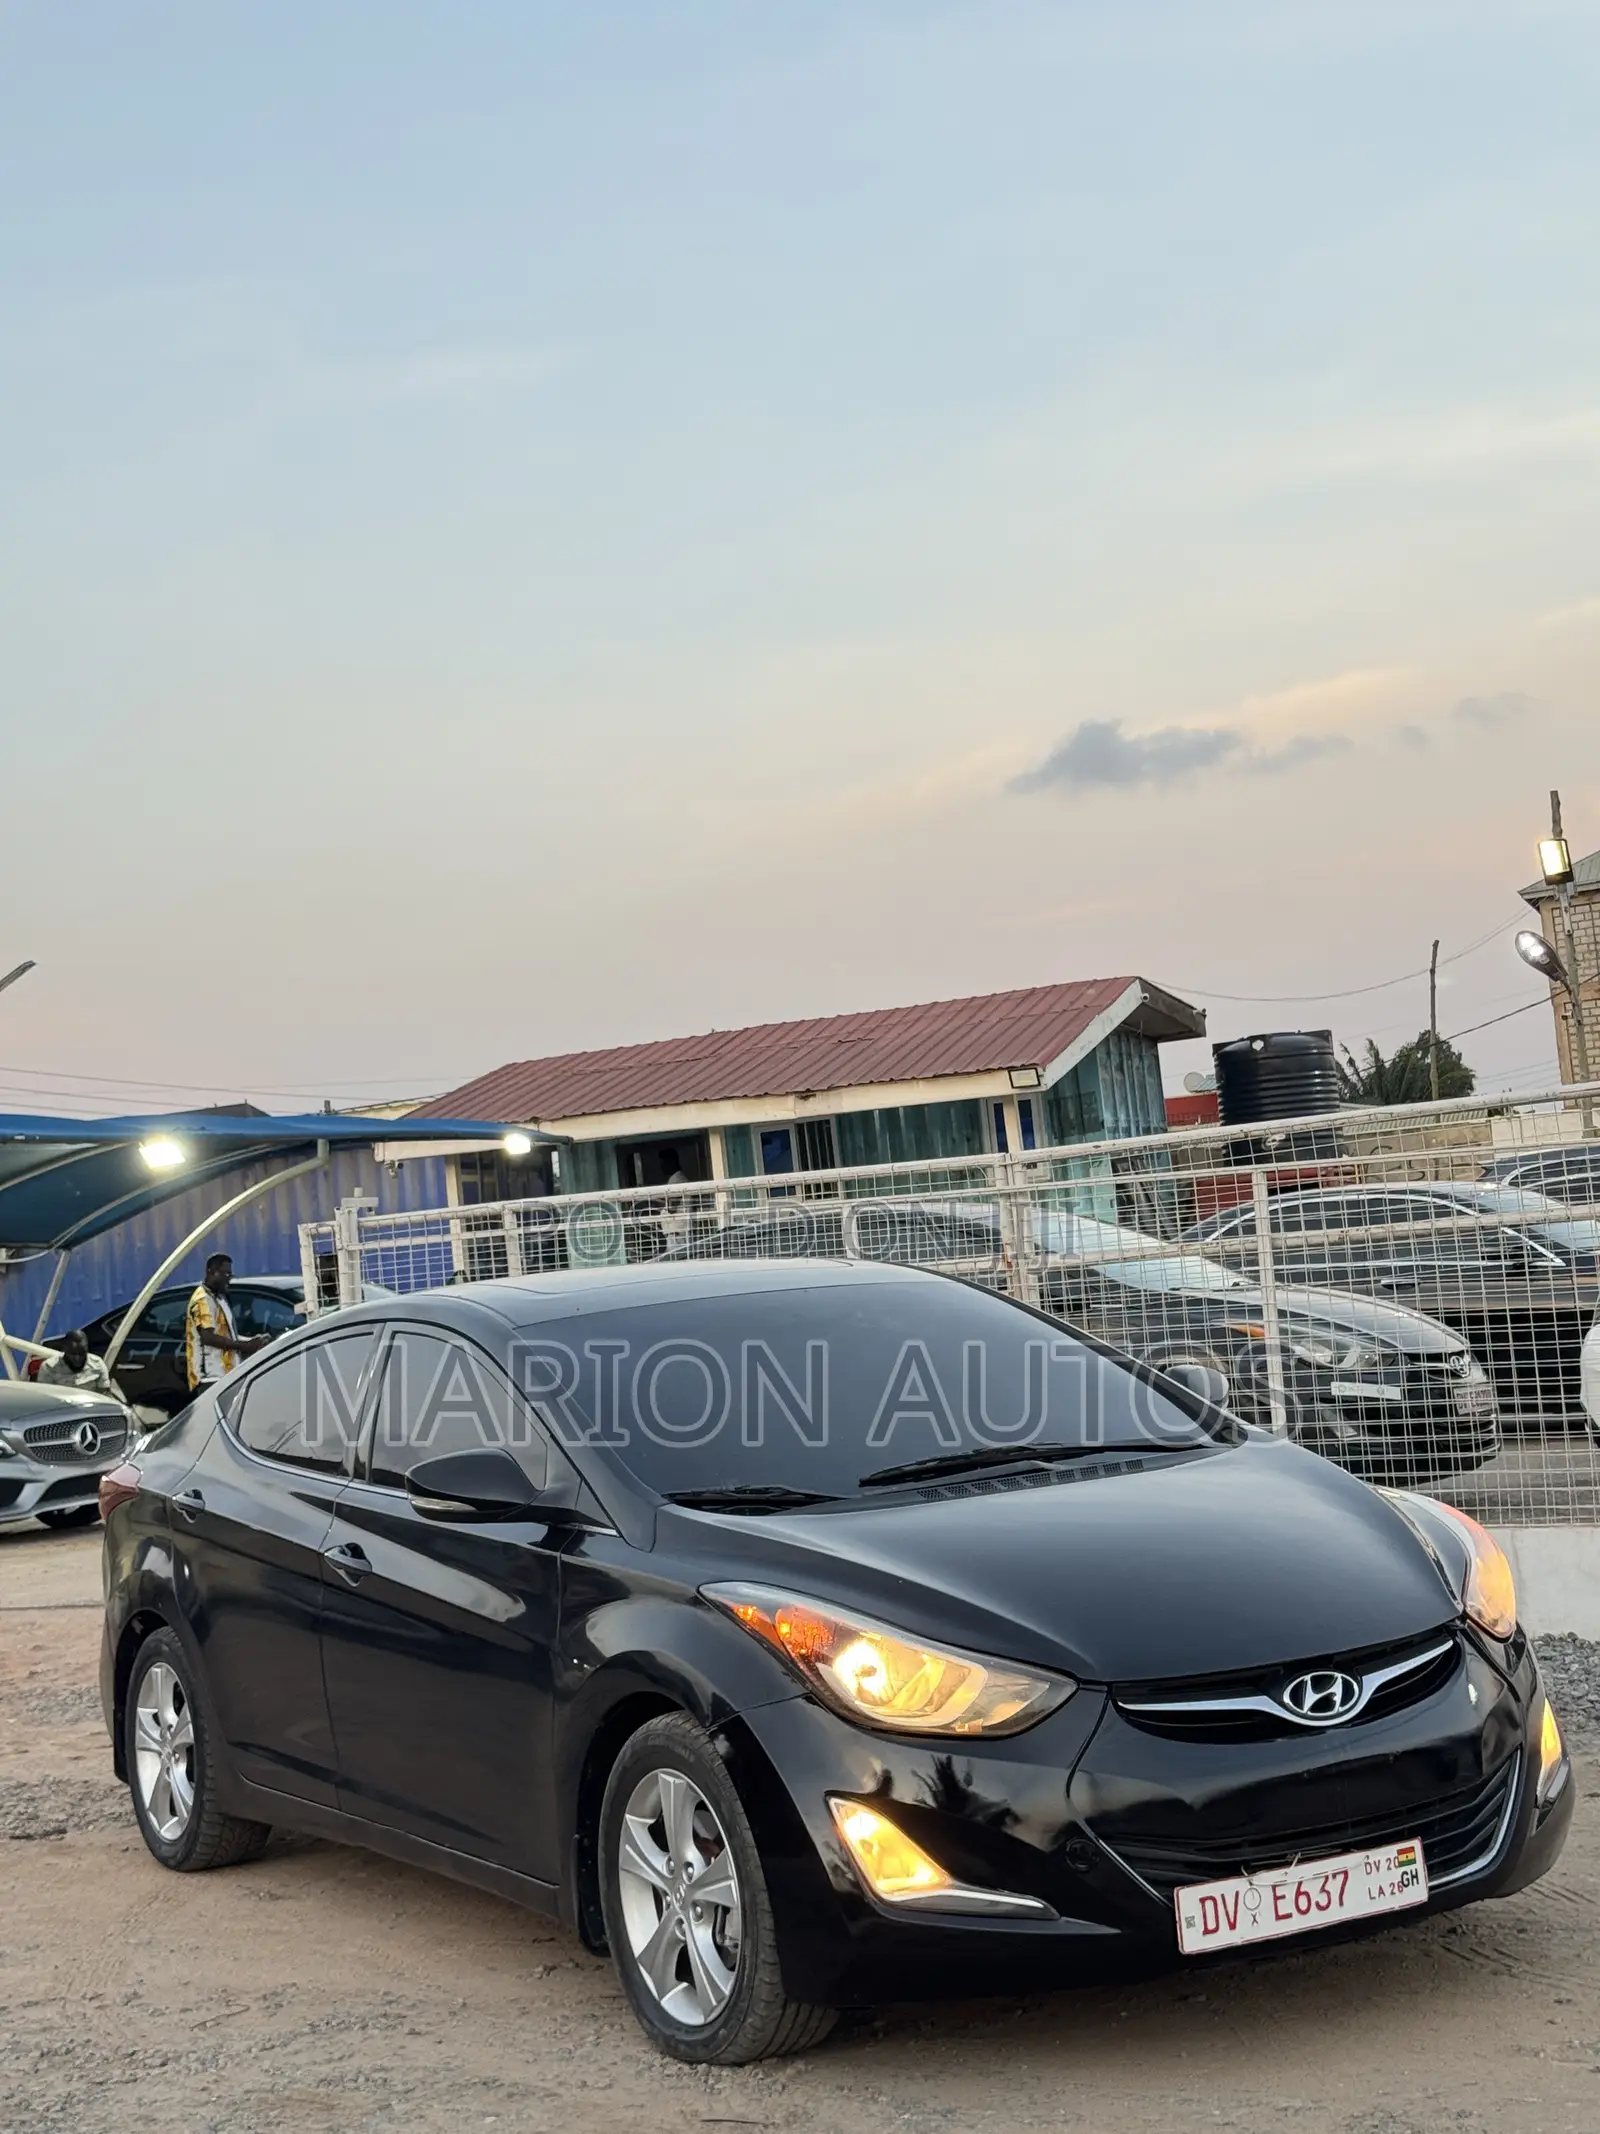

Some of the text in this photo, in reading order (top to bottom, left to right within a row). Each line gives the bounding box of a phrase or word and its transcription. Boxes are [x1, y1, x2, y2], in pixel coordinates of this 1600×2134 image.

[1363, 1859, 1381, 1876] DV
[1400, 1867, 1420, 1888] GH
[1367, 1884, 1387, 1901] LA
[1198, 1869, 1349, 1937] DV E637
